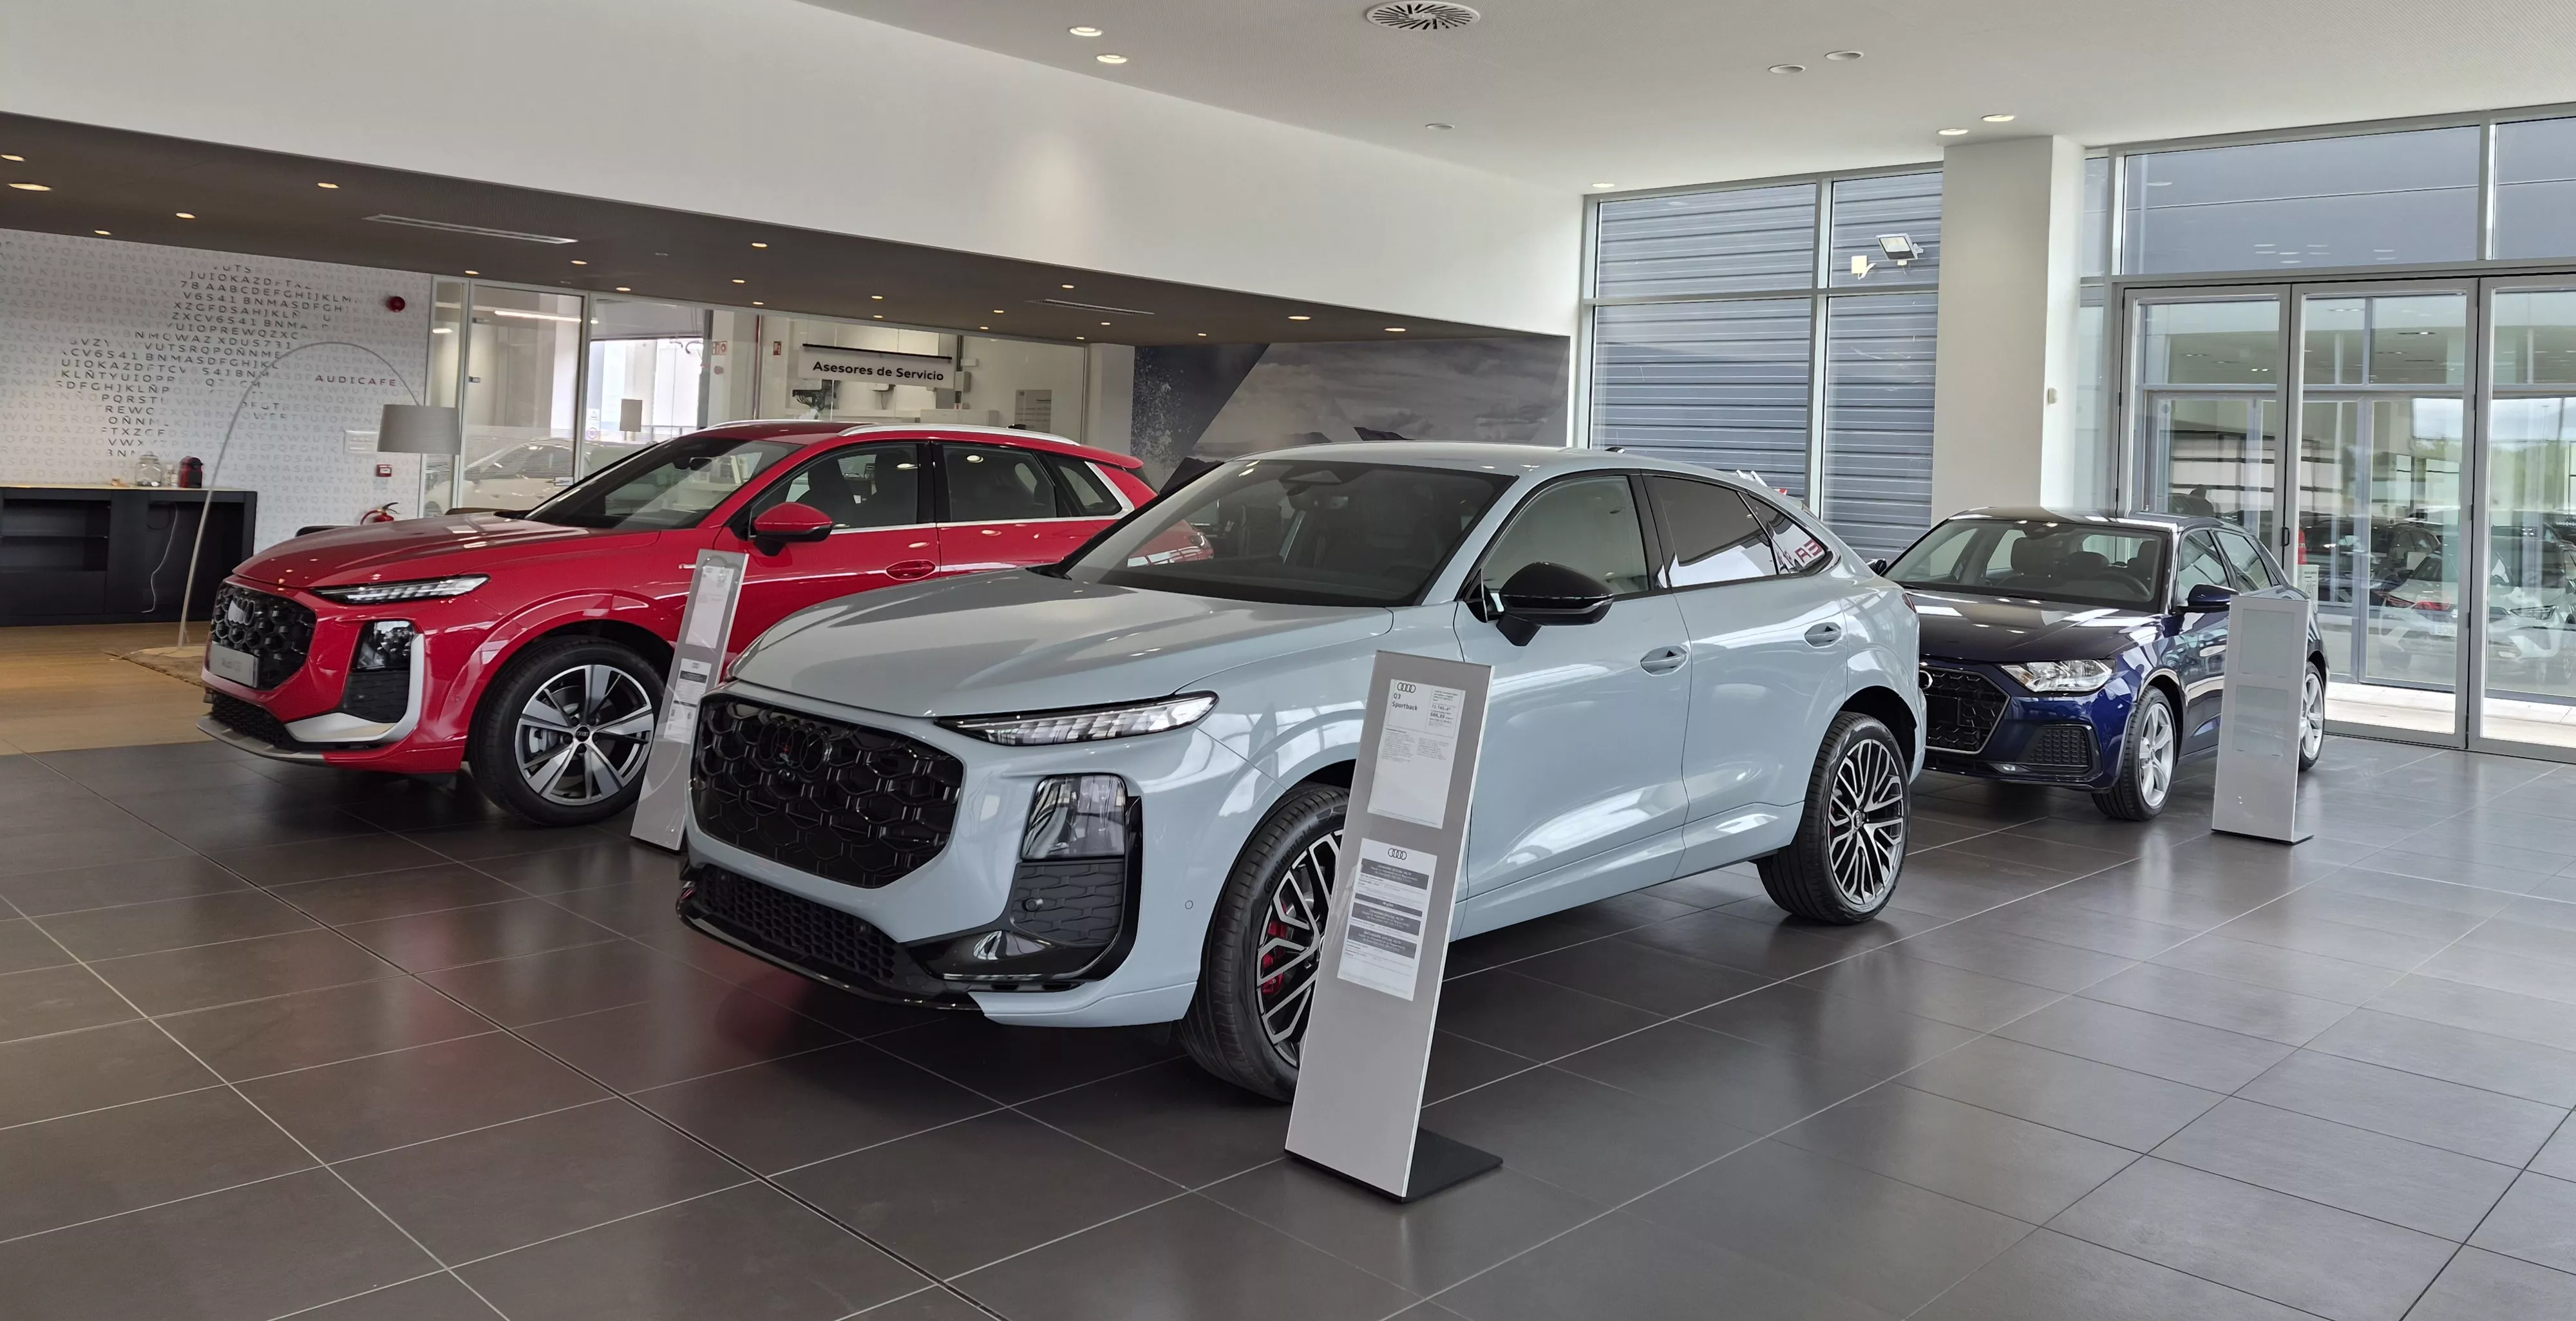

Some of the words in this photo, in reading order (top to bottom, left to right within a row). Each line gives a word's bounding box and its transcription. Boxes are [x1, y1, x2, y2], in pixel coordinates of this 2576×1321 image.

[813, 361, 873, 375] Asesores
[877, 366, 893, 376] de
[896, 368, 944, 381] Servicio
[316, 375, 395, 386] AUDICAFE
[1392, 701, 1418, 711] Sportback
